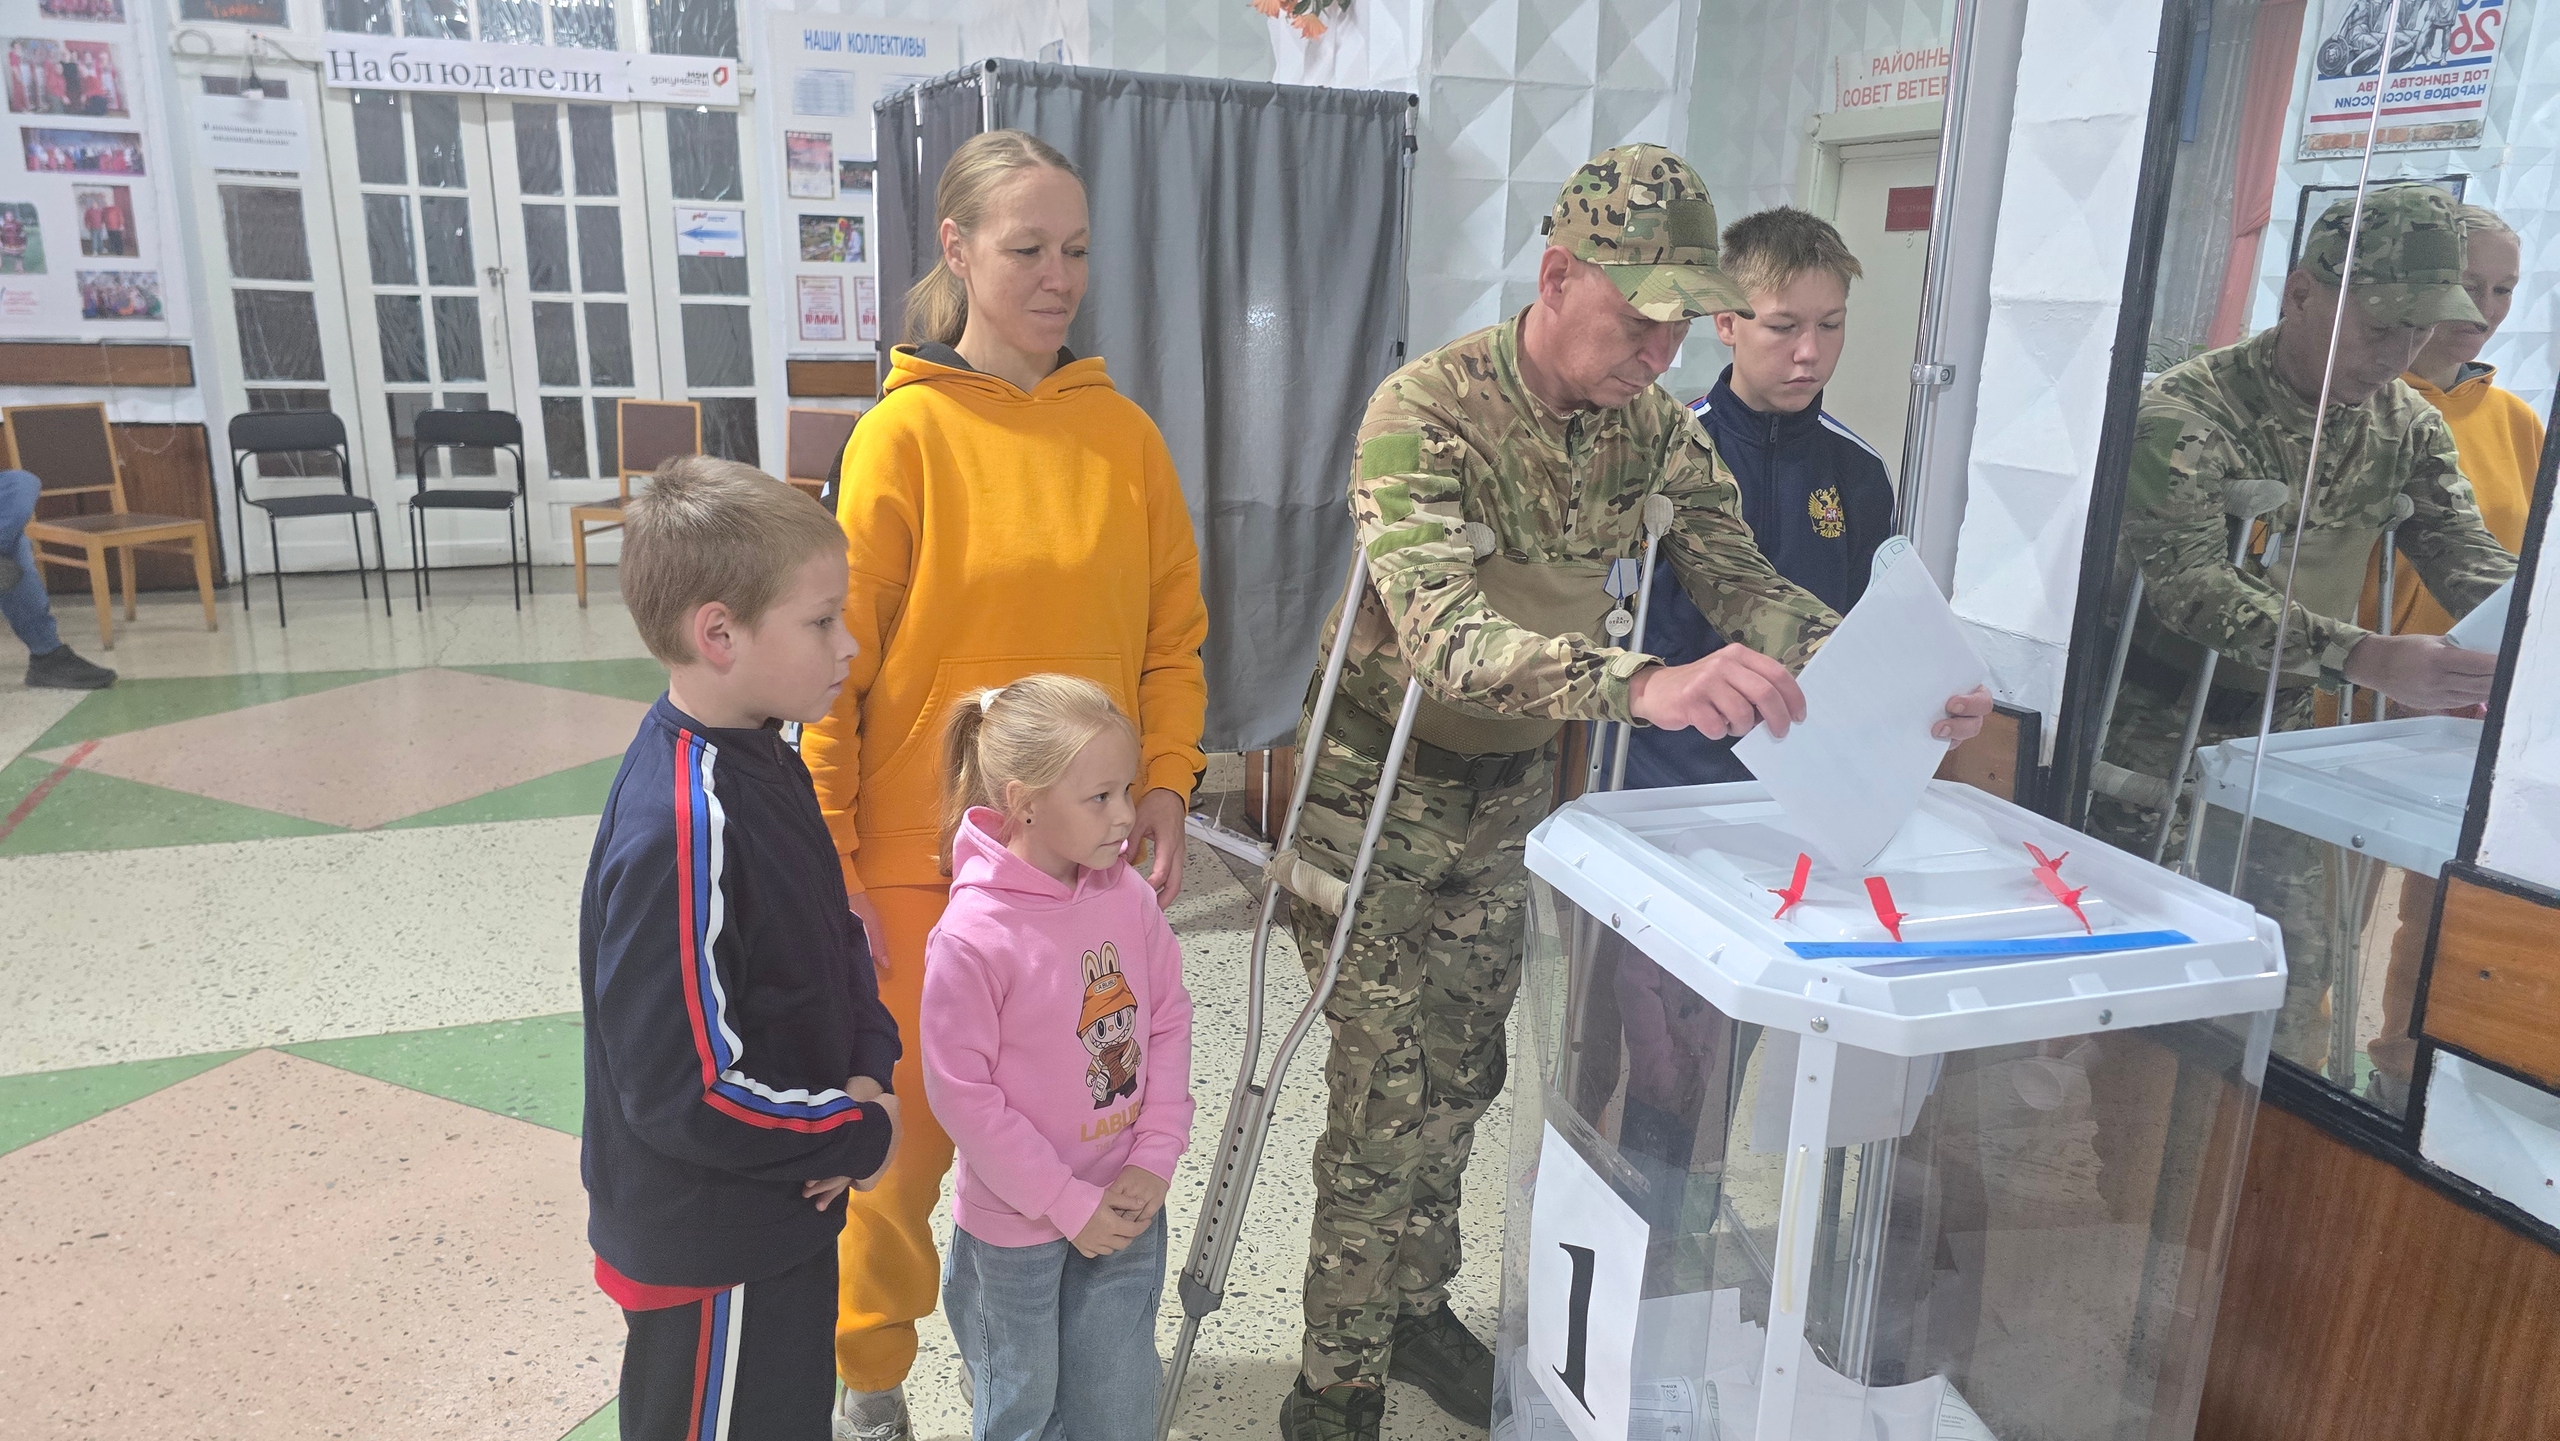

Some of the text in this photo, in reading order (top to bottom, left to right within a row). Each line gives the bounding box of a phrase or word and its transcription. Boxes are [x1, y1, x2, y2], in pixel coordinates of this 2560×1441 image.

[804, 29, 926, 58] НАШИ КОЛЛЕКТИВЫ
[1872, 46, 1951, 77] РАЙОННЫ
[329, 50, 602, 94] Наблюдатели
[1843, 76, 1948, 107] СОВЕТ ВЕТЕР
[1081, 1097, 1141, 1143] LABUB
[1551, 1241, 1596, 1421] 1
